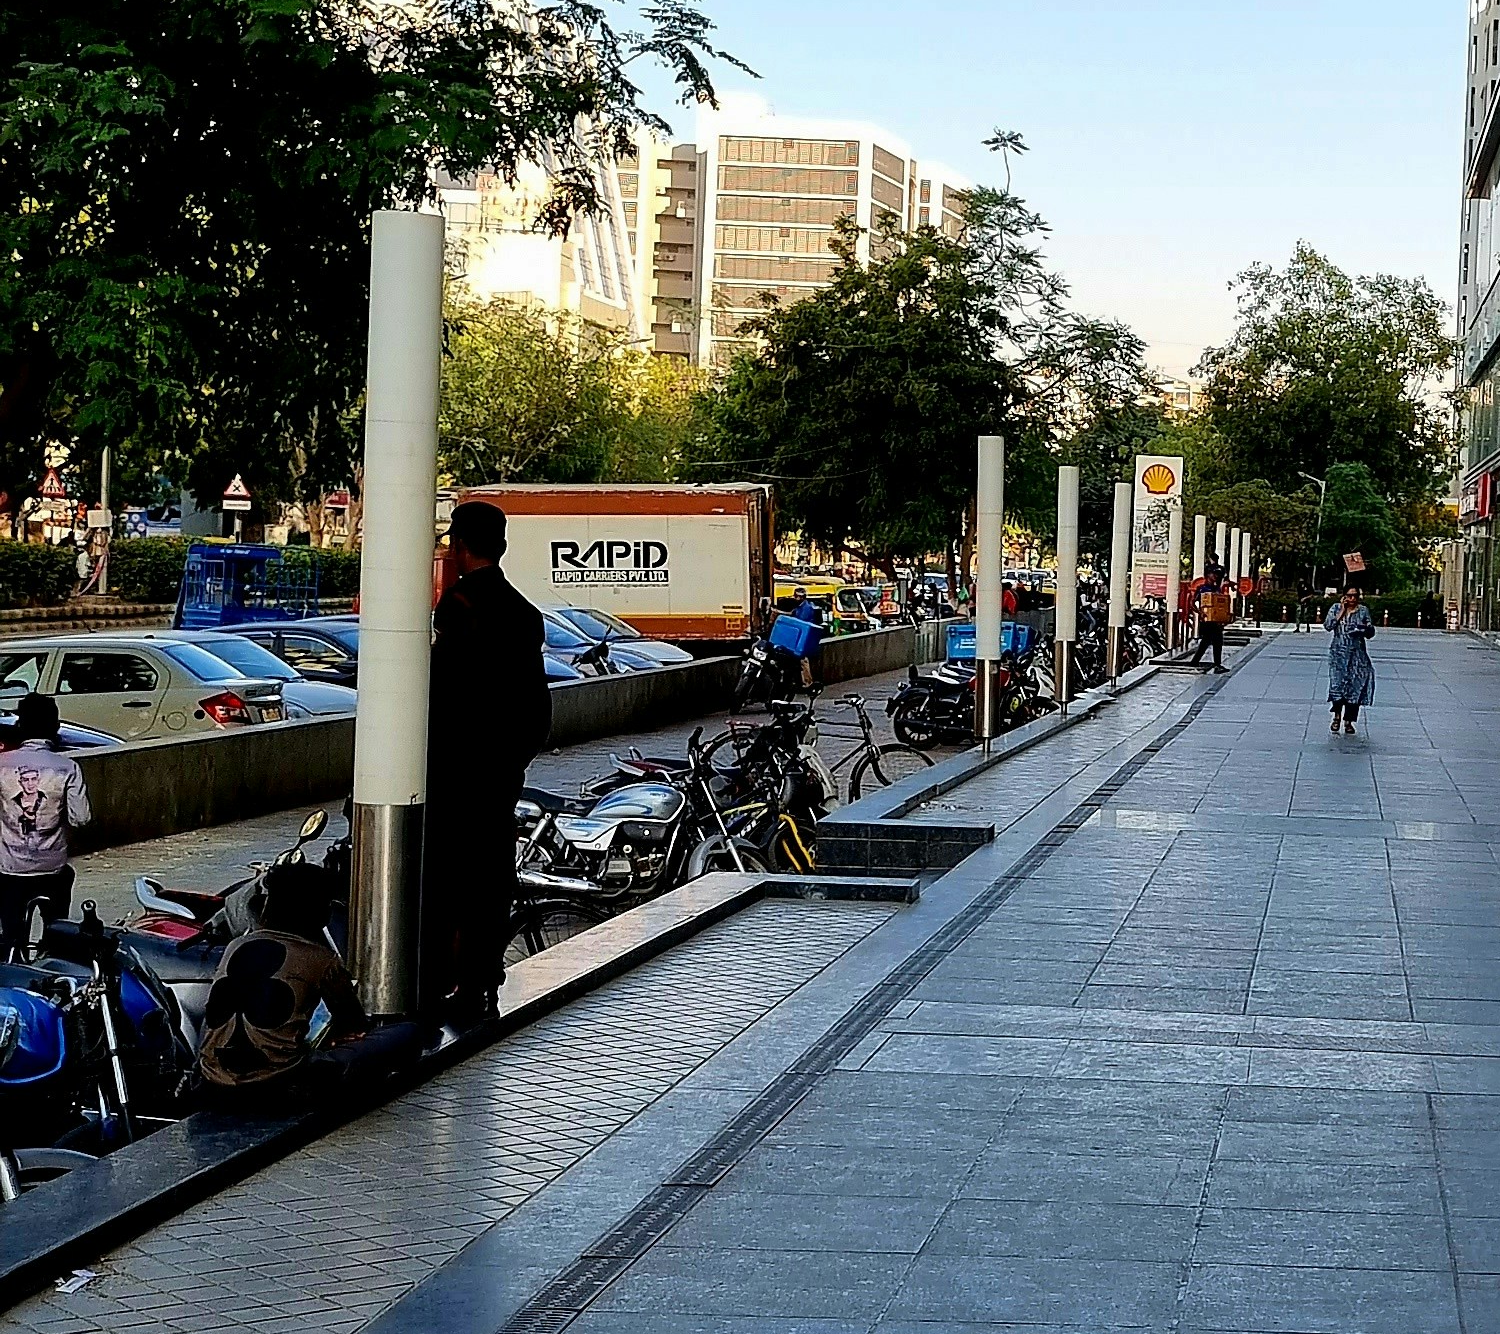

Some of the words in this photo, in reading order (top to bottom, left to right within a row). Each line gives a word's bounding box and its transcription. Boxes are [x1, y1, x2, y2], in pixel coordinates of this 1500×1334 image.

[555, 571, 581, 582] RAPID
[583, 571, 627, 581] CARRIERS
[629, 570, 647, 581] PVT.
[649, 570, 667, 581] LTD.
